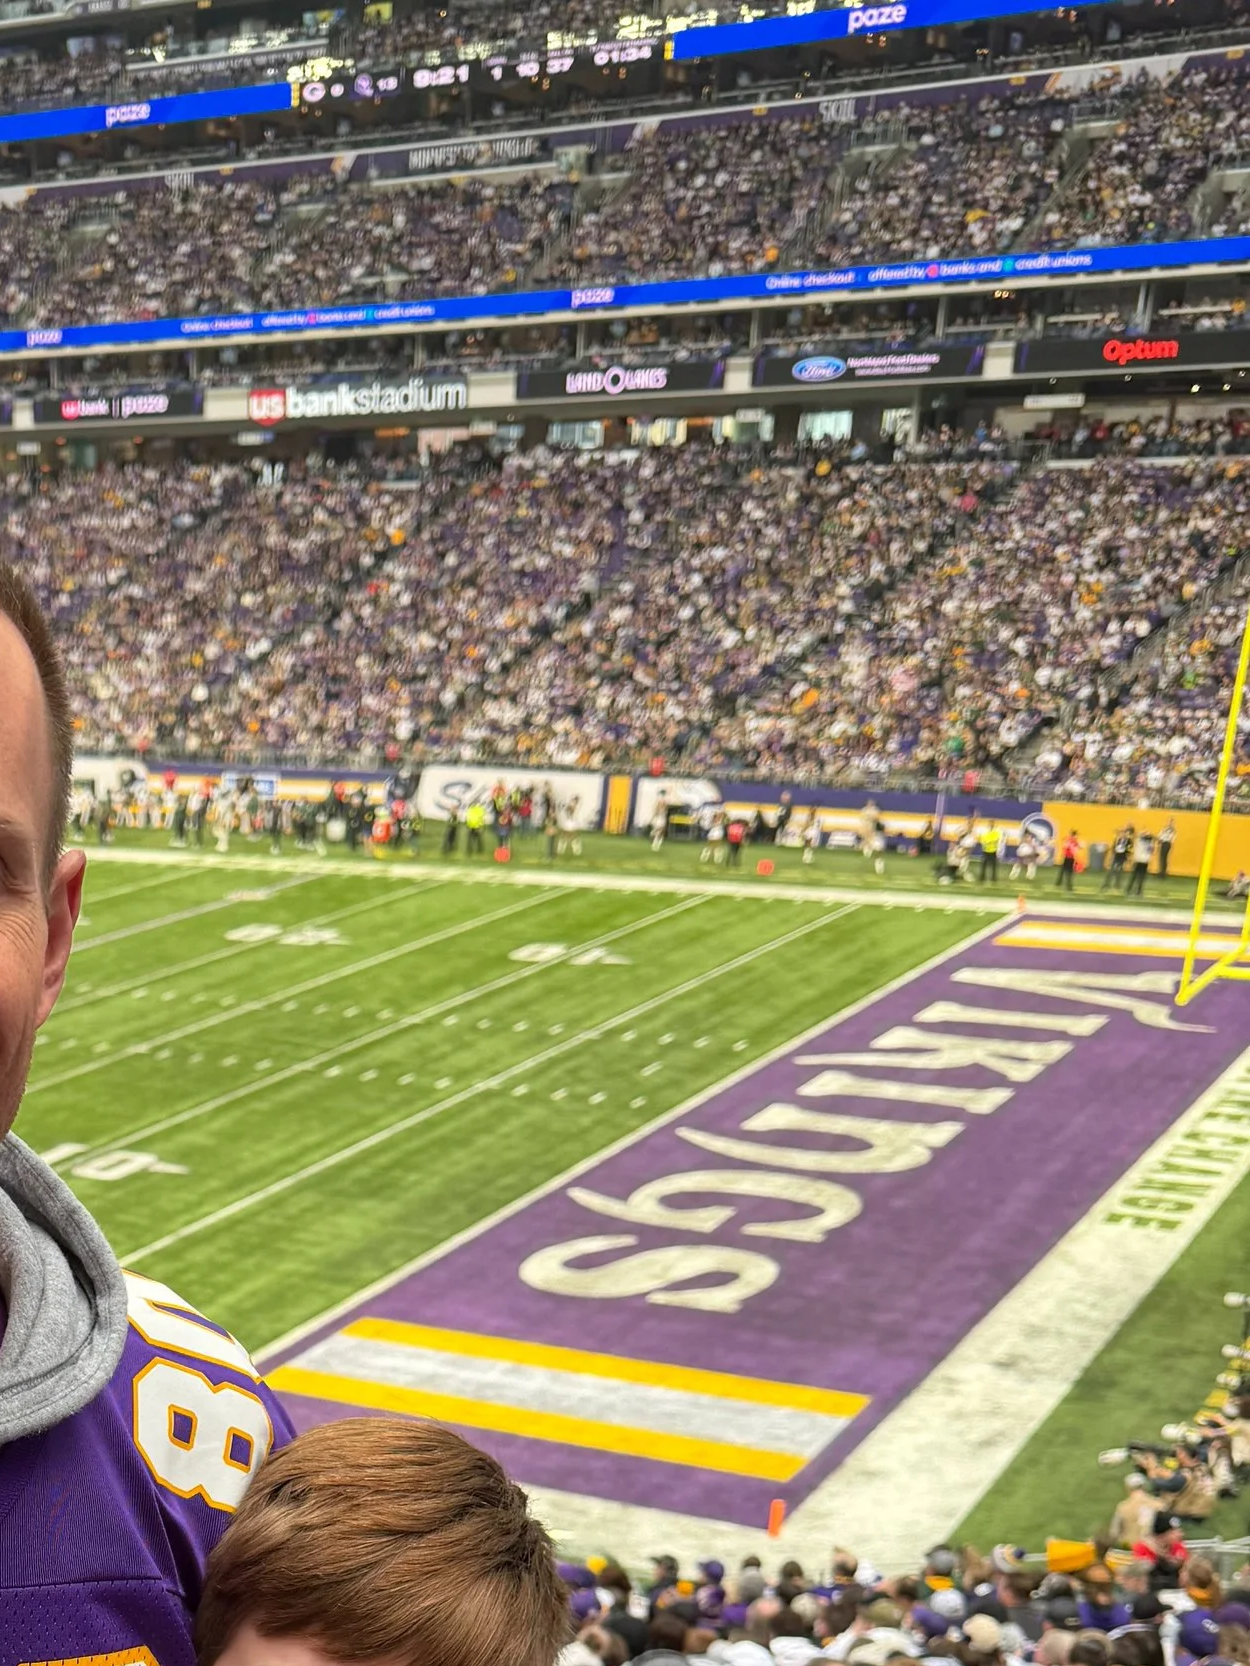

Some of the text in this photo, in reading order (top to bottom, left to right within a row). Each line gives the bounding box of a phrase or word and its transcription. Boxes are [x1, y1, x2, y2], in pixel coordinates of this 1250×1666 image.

[848, 4, 907, 33] paze
[1103, 338, 1179, 366] Optum
[518, 966, 1218, 1314] VIKINGS
